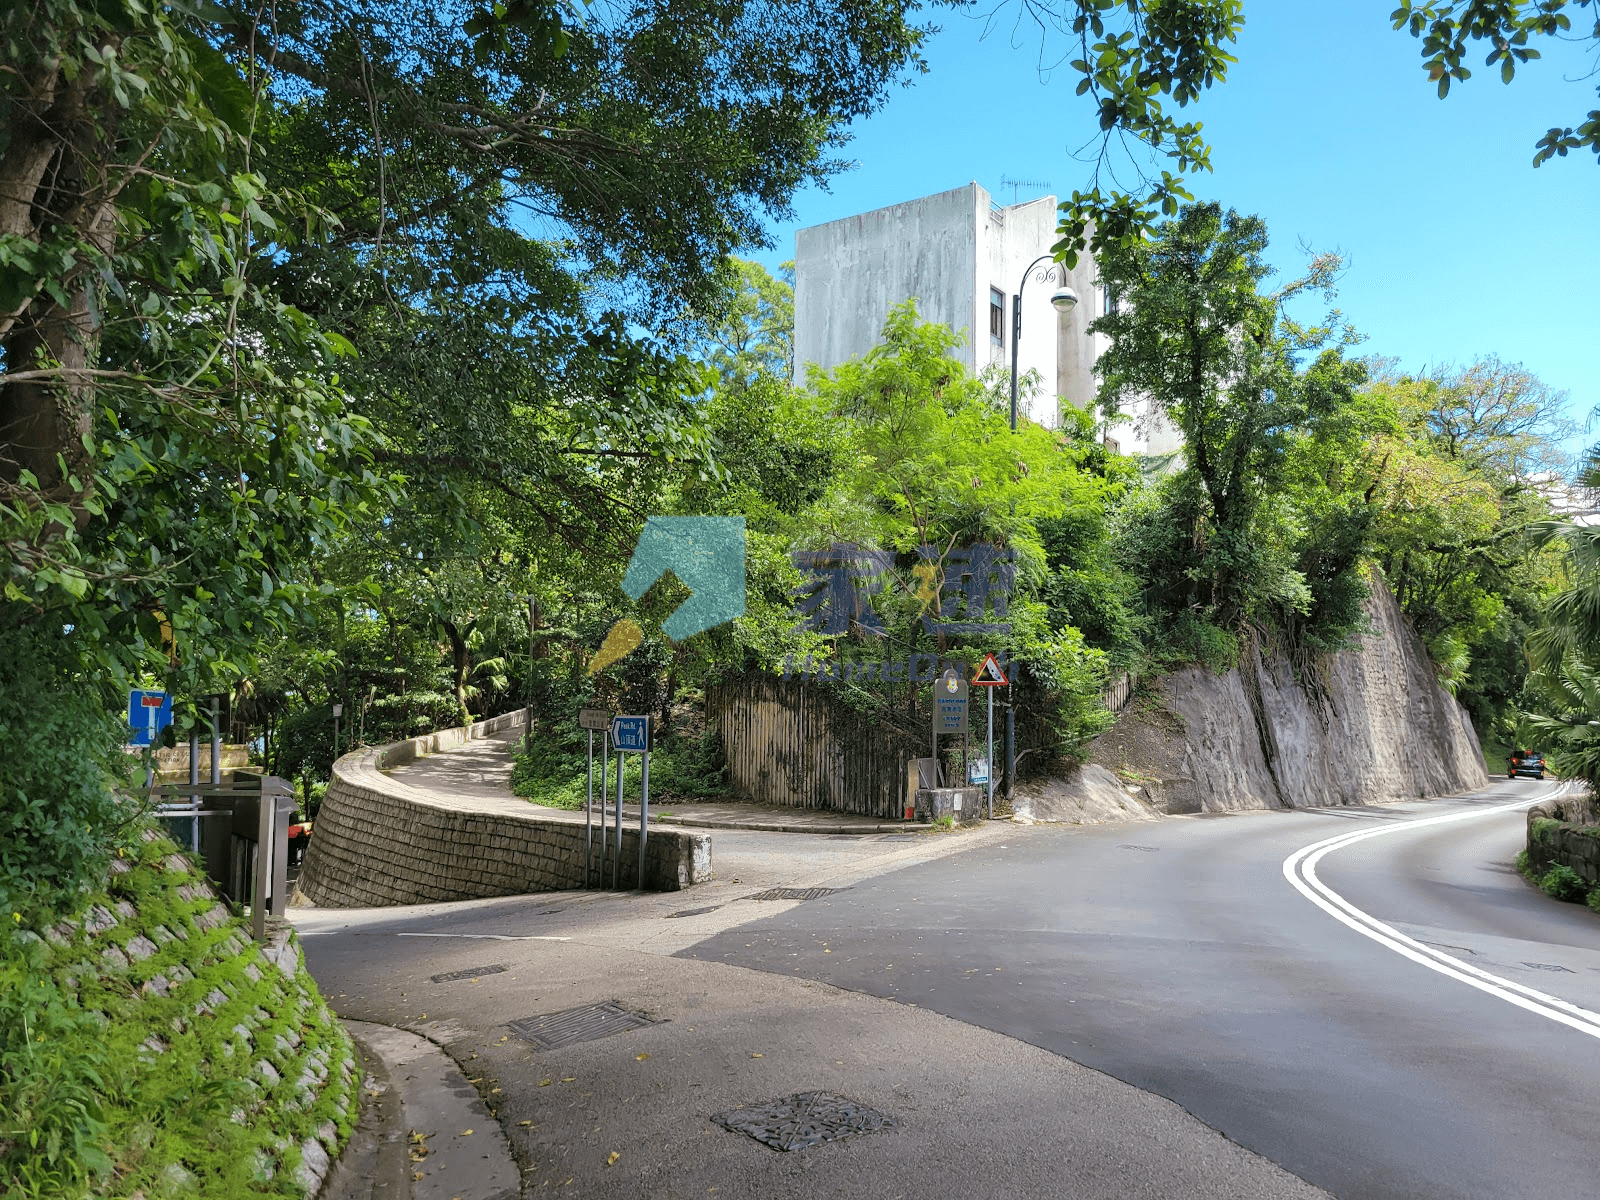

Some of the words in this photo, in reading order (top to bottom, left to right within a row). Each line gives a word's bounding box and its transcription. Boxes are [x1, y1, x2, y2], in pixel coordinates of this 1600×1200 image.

[620, 721, 630, 730] Peak
[620, 734, 636, 746] 山頂道
